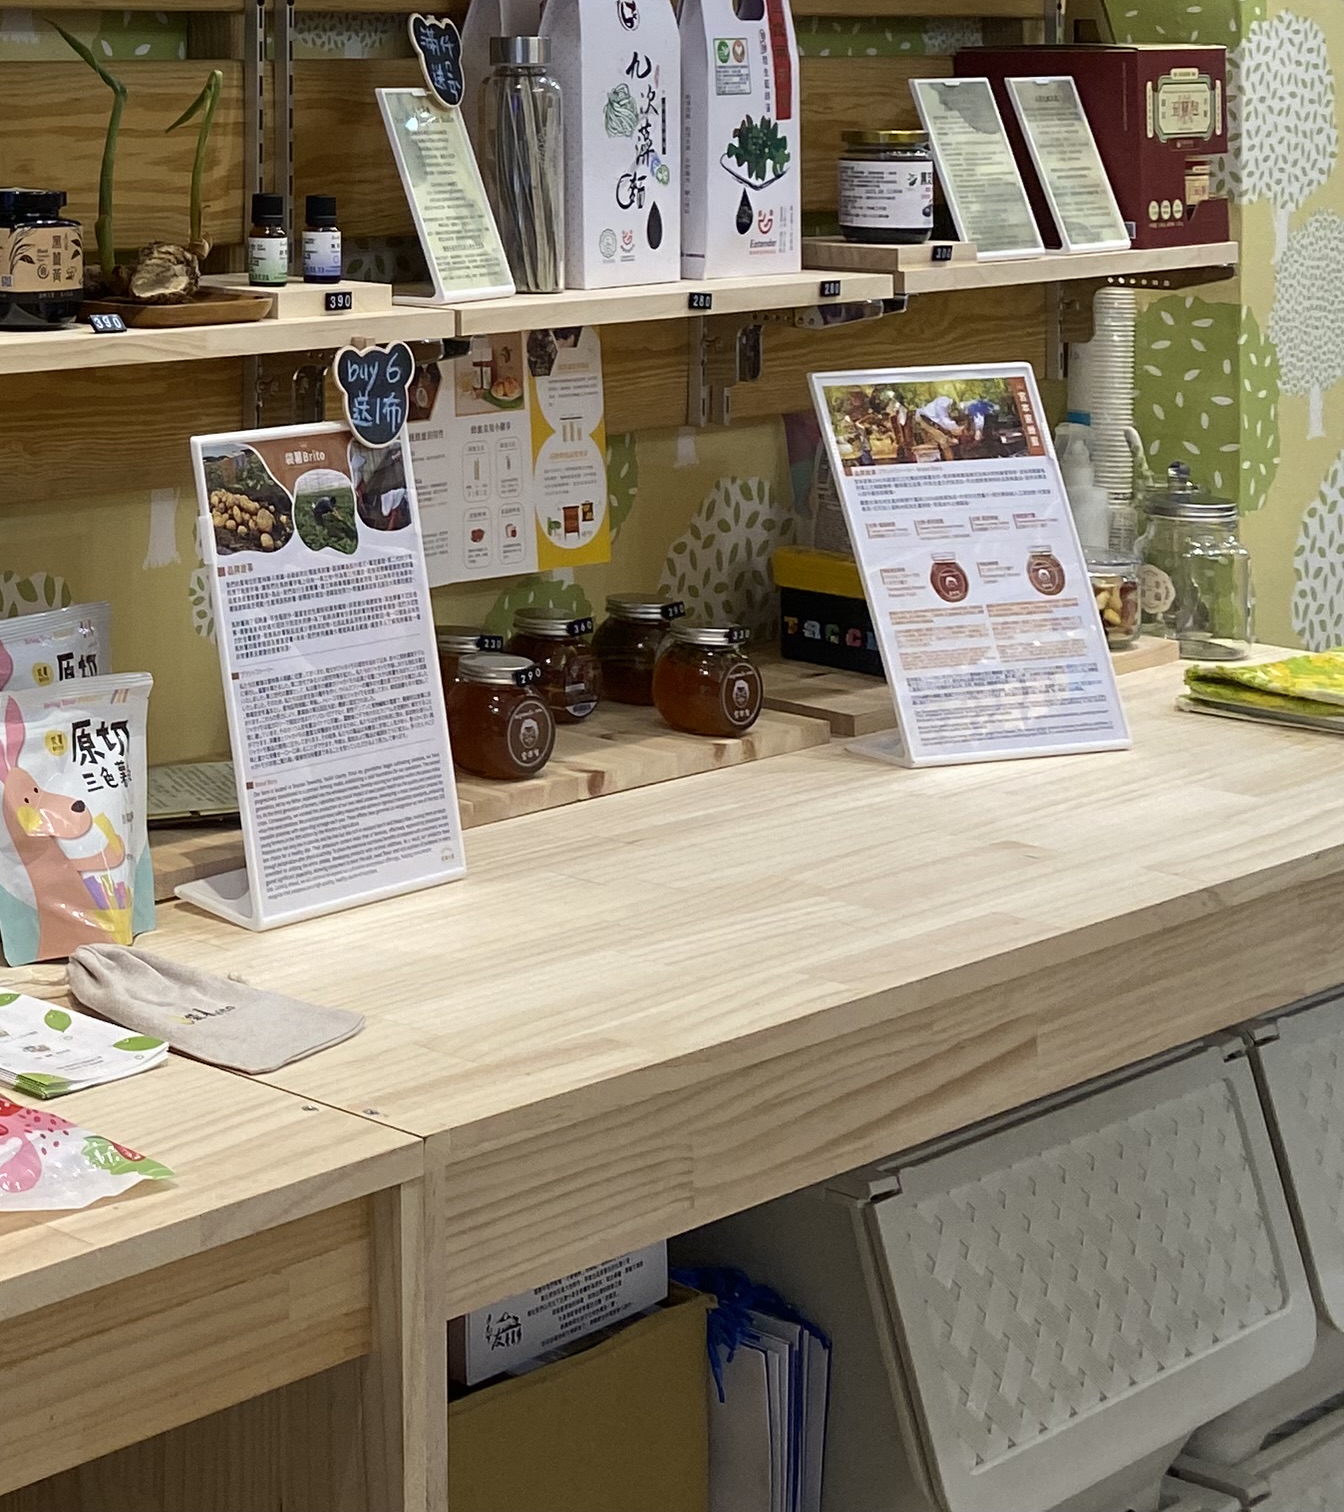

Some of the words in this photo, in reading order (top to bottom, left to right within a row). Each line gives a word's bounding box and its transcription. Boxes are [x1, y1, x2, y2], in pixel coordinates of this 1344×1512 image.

[329, 296, 351, 308] 390
[694, 295, 712, 307] 280
[94, 315, 122, 330] 390
[347, 359, 379, 397] buy
[386, 353, 401, 382] 6
[573, 620, 592, 634] 360
[484, 638, 502, 649] 230
[519, 667, 541, 684] 290
[71, 719, 131, 767] 原切
